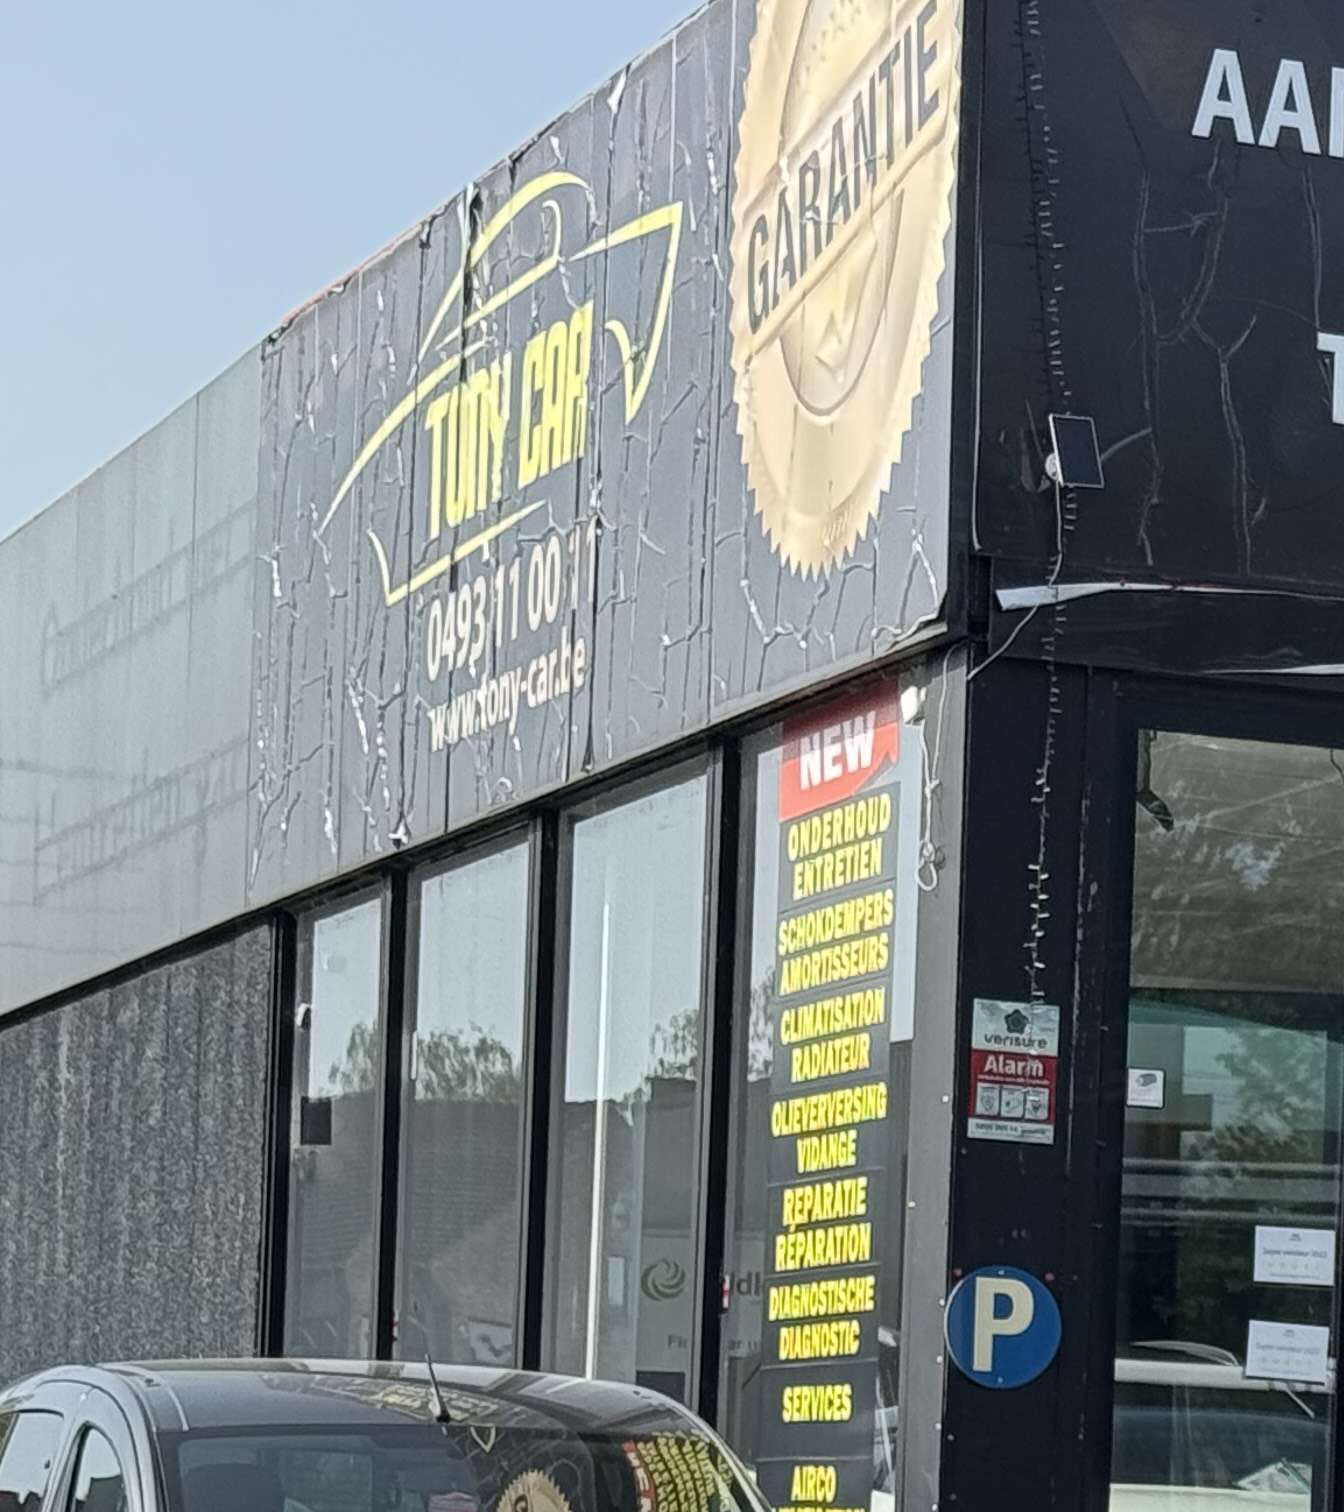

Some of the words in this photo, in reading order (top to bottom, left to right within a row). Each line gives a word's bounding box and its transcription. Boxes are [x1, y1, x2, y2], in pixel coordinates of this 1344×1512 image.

[749, 0, 939, 335] GARANTIE
[424, 350, 513, 540] TONY
[518, 299, 594, 489] CAR
[427, 575, 487, 682] 0493
[494, 556, 522, 648] 11
[528, 536, 562, 632] 00
[427, 625, 586, 752] www.tony-car.be
[800, 710, 876, 791] NEW
[788, 792, 891, 862] ONDERHOUD
[793, 838, 883, 901] ENTRETIEN
[778, 888, 894, 956] SCHOKDEMPERS
[779, 932, 889, 996] AMORTISSEURS
[780, 986, 885, 1046] CLIMATISATION
[984, 1033, 1048, 1049] verisure
[791, 1032, 871, 1083] RADIATEUR
[984, 1054, 1044, 1077] Alarm
[771, 1082, 888, 1137] OLIEVERVERSING
[797, 1129, 857, 1174] VIDANGE
[783, 1176, 868, 1227] REPARATIE
[768, 1275, 876, 1321] DIAGNOSTISCHE
[973, 1276, 1035, 1372] P
[779, 1319, 860, 1360] DIAGNOSTIC
[782, 1383, 852, 1423] SERVICES
[791, 1465, 837, 1502] AIRCO
